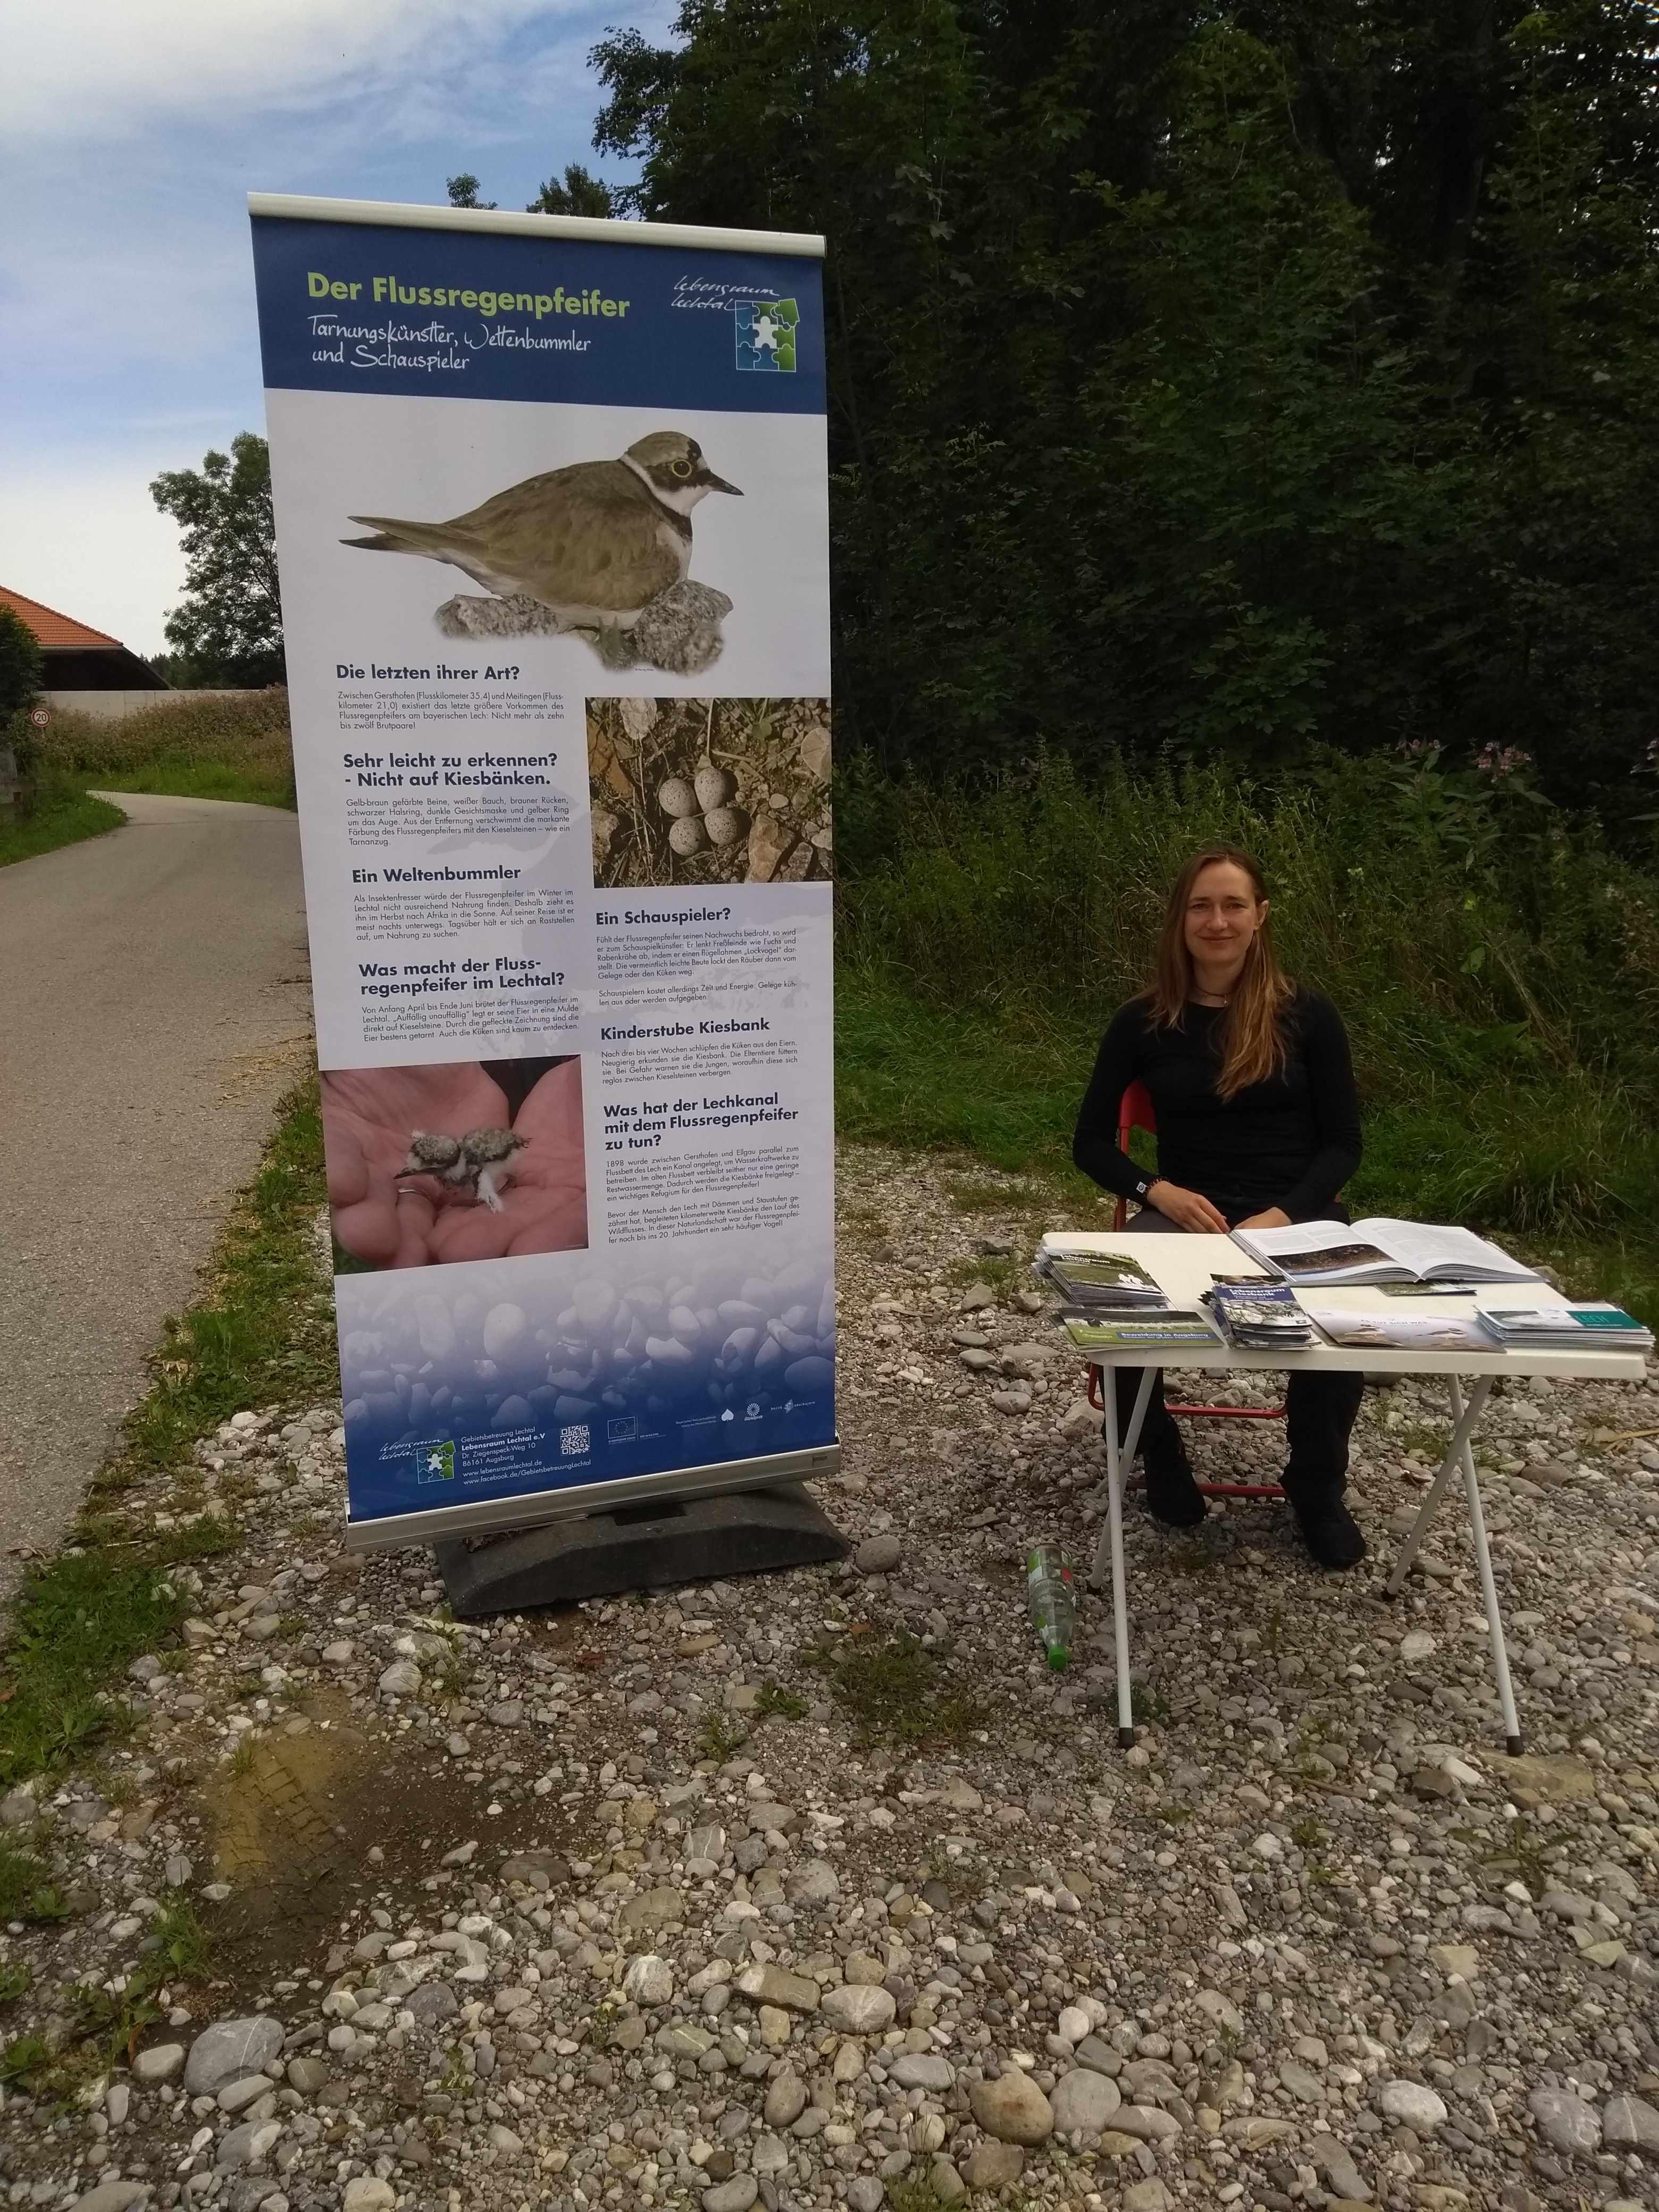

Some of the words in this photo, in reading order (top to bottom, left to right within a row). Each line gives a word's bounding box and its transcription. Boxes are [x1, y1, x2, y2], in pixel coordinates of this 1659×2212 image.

[674, 275, 780, 297] lebensraum
[307, 272, 362, 301] Der
[373, 275, 631, 320] Flussregenpfeifer
[312, 341, 344, 364] und
[350, 344, 470, 372] Schauspieler
[336, 664, 365, 678] Die
[371, 664, 430, 679] letzten
[437, 664, 478, 680] ihrer
[484, 666, 520, 680] Art?
[374, 691, 415, 699] Gersthofen
[416, 691, 469, 702] (Flusskilometer
[506, 692, 541, 702] Meitingen
[543, 691, 563, 702] (Fluss-
[338, 700, 373, 709] kilometer
[433, 701, 447, 709] das
[451, 701, 470, 709] letzte
[474, 701, 502, 712] größere
[506, 701, 548, 709] Vorkommen
[343, 752, 383, 768] Sehr
[389, 752, 435, 767] leicht
[441, 757, 461, 767] zu
[467, 752, 557, 767] erkennen?
[357, 771, 404, 786] Nicht
[409, 770, 439, 786] auf
[445, 770, 550, 785] Kiesbänken.
[346, 798, 388, 806] Gelb-braun
[392, 797, 423, 808] gefärbte
[427, 798, 449, 807] Beine,
[482, 796, 506, 807] Bauch,
[541, 795, 568, 805] Rücken,
[347, 808, 386, 816] schwarzer
[389, 807, 422, 817] Halsring,
[454, 806, 507, 814] Gesichtsmaske
[527, 805, 550, 815] gelber
[554, 806, 569, 815] Ring
[352, 868, 378, 883] Ein
[382, 865, 521, 882] Weltenbummler
[368, 893, 421, 902] Insektenfresser
[465, 889, 524, 901] Flussregenpfeifer
[354, 903, 380, 912] Lechtal
[404, 901, 448, 910] ausreichend
[451, 901, 483, 911] Nahrung
[487, 899, 511, 907] finden.
[596, 911, 618, 925] Ein
[624, 907, 731, 925] Schauspieler?
[626, 932, 681, 944] Flussregenpfeifer
[705, 930, 742, 939] Nachwuchs
[744, 929, 770, 939] bedroht,
[358, 963, 397, 977] Was
[404, 959, 456, 975] macht
[462, 958, 490, 973] der
[495, 957, 541, 970] Fluss-
[361, 977, 467, 998] regenpfeifer
[473, 976, 493, 989] im
[499, 971, 564, 988] Lechtal?
[601, 1022, 694, 1040] Kinderstube
[699, 1017, 770, 1034] Kiesbank
[601, 1058, 635, 1067] Neugierig
[638, 1055, 668, 1064] erkunden
[604, 1104, 638, 1117] Was
[643, 1101, 668, 1115] hat
[673, 1099, 698, 1112] der
[703, 1092, 778, 1109] Lechkanal
[605, 1120, 629, 1134] mit
[633, 1118, 666, 1132] dem
[670, 1107, 798, 1128] Flussregenpfeifer
[605, 1141, 623, 1150] zu
[628, 1134, 661, 1148] tun?
[651, 1155, 681, 1163] zwischen
[684, 1151, 718, 1160] Gersthofen
[736, 1148, 756, 1159] Ellgau
[758, 1145, 782, 1157] parallel
[674, 1161, 692, 1170] Kanal
[693, 1159, 722, 1170] angelegt,
[734, 1154, 790, 1164] Wasserkraftwerke
[1060, 1254, 1110, 1264] Lebensraum
[460, 1431, 513, 1443] Gebietsbetreuung
[515, 1426, 535, 1435] Lechtal
[462, 1440, 505, 1451] Lebensraum
[507, 1434, 531, 1444] Lechtal
[473, 1444, 525, 1457] Ziegenspeck-Weg
[463, 1458, 482, 1467] 86161
[485, 1454, 514, 1463] Augsburg
[463, 1459, 542, 1477] www.lebensraumlechtal.de
